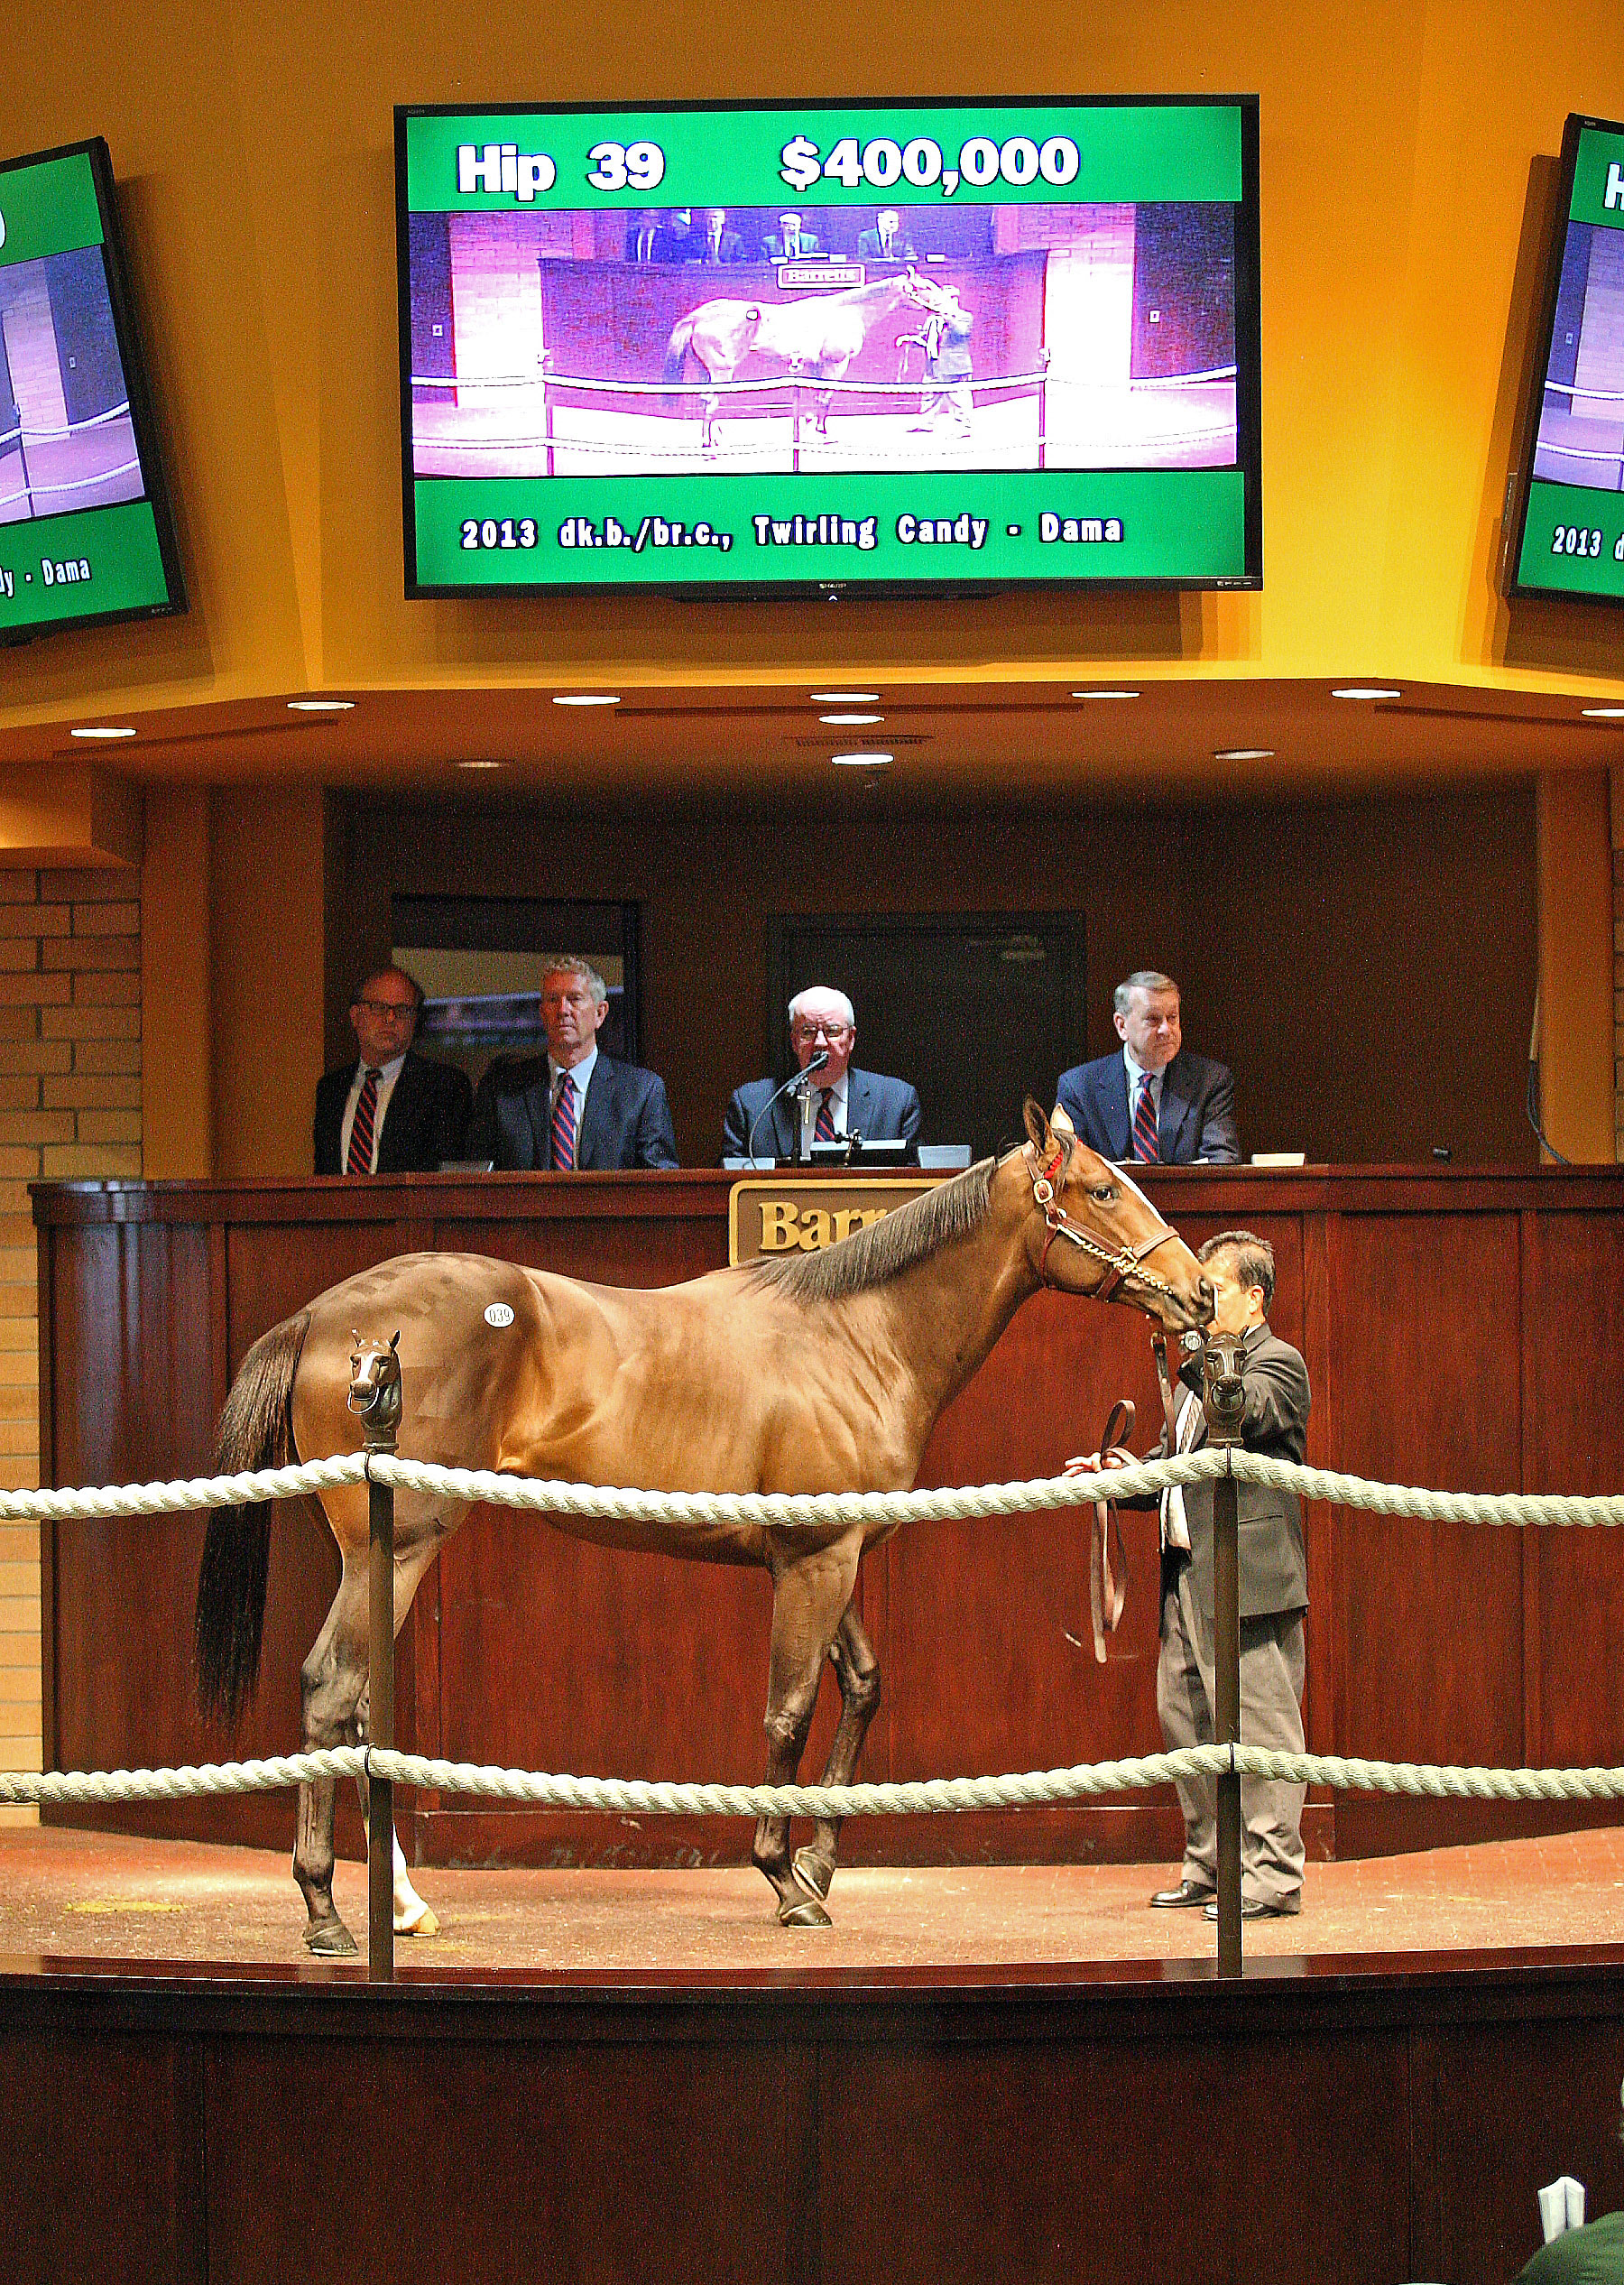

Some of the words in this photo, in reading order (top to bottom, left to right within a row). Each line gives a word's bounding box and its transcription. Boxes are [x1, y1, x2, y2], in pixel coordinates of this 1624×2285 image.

[457, 143, 557, 202] Hip
[586, 141, 666, 191] 39
[780, 134, 1080, 197] $400,000
[460, 519, 538, 549] 2013
[558, 516, 733, 552] dk.b./br.c.,
[752, 515, 878, 549] Twirling
[896, 513, 989, 549] Candy
[1039, 513, 1124, 543] Dama
[1552, 526, 1601, 557] 2013
[42, 559, 91, 587] Dama
[489, 1308, 511, 1323] 039
